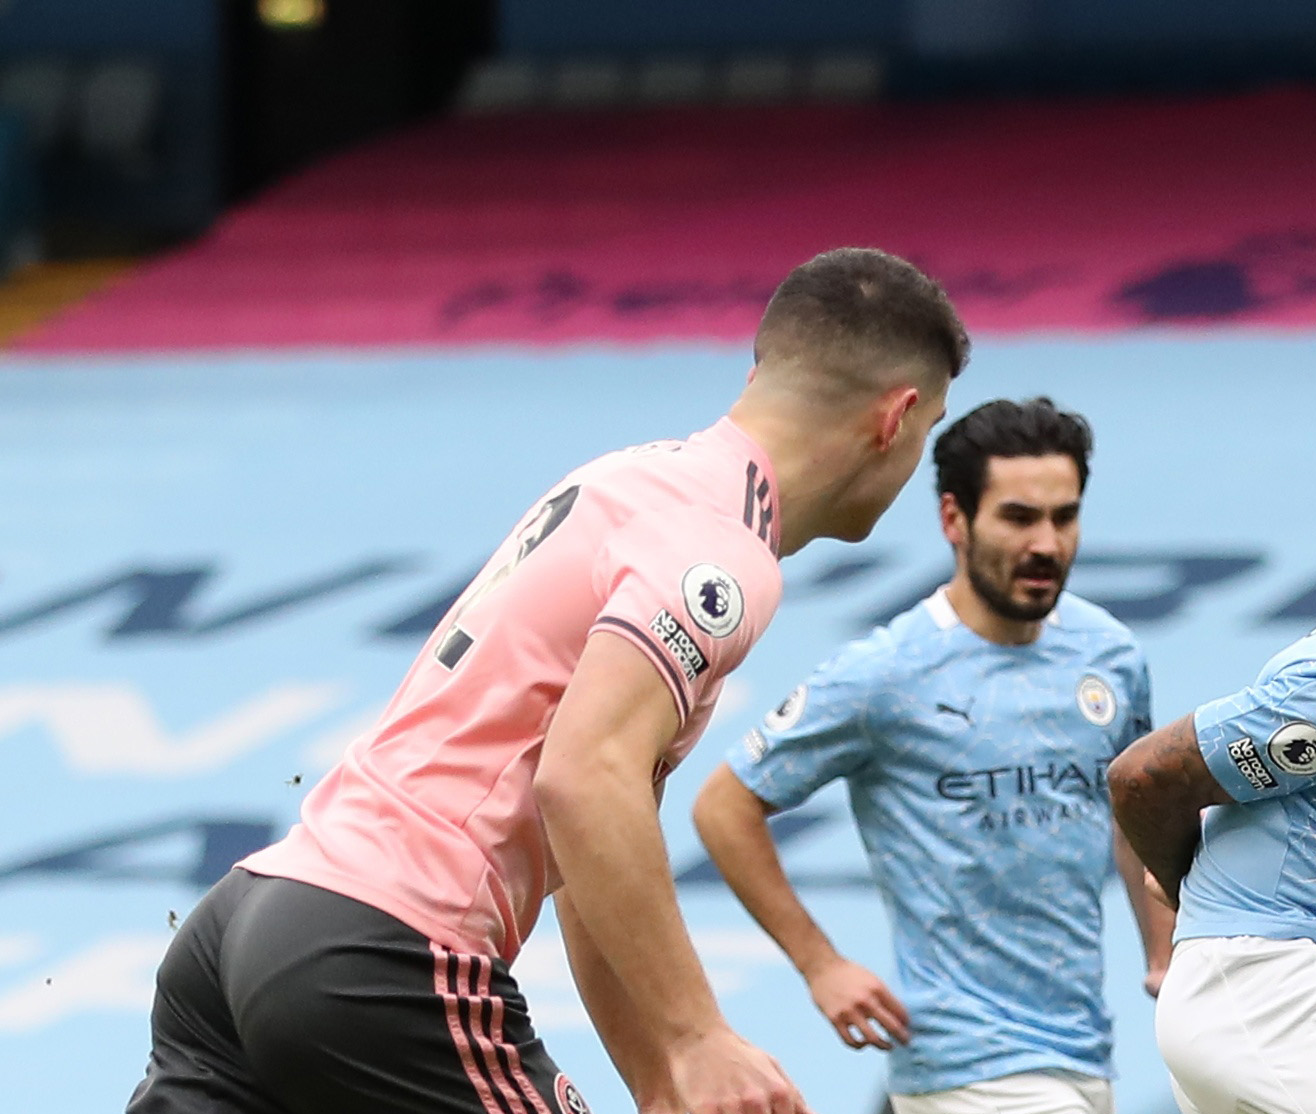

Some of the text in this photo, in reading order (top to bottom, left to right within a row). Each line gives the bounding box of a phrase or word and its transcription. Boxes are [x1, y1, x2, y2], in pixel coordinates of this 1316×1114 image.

[655, 609, 705, 670] No room
[1228, 741, 1244, 760] for
[1237, 737, 1273, 785] No room
